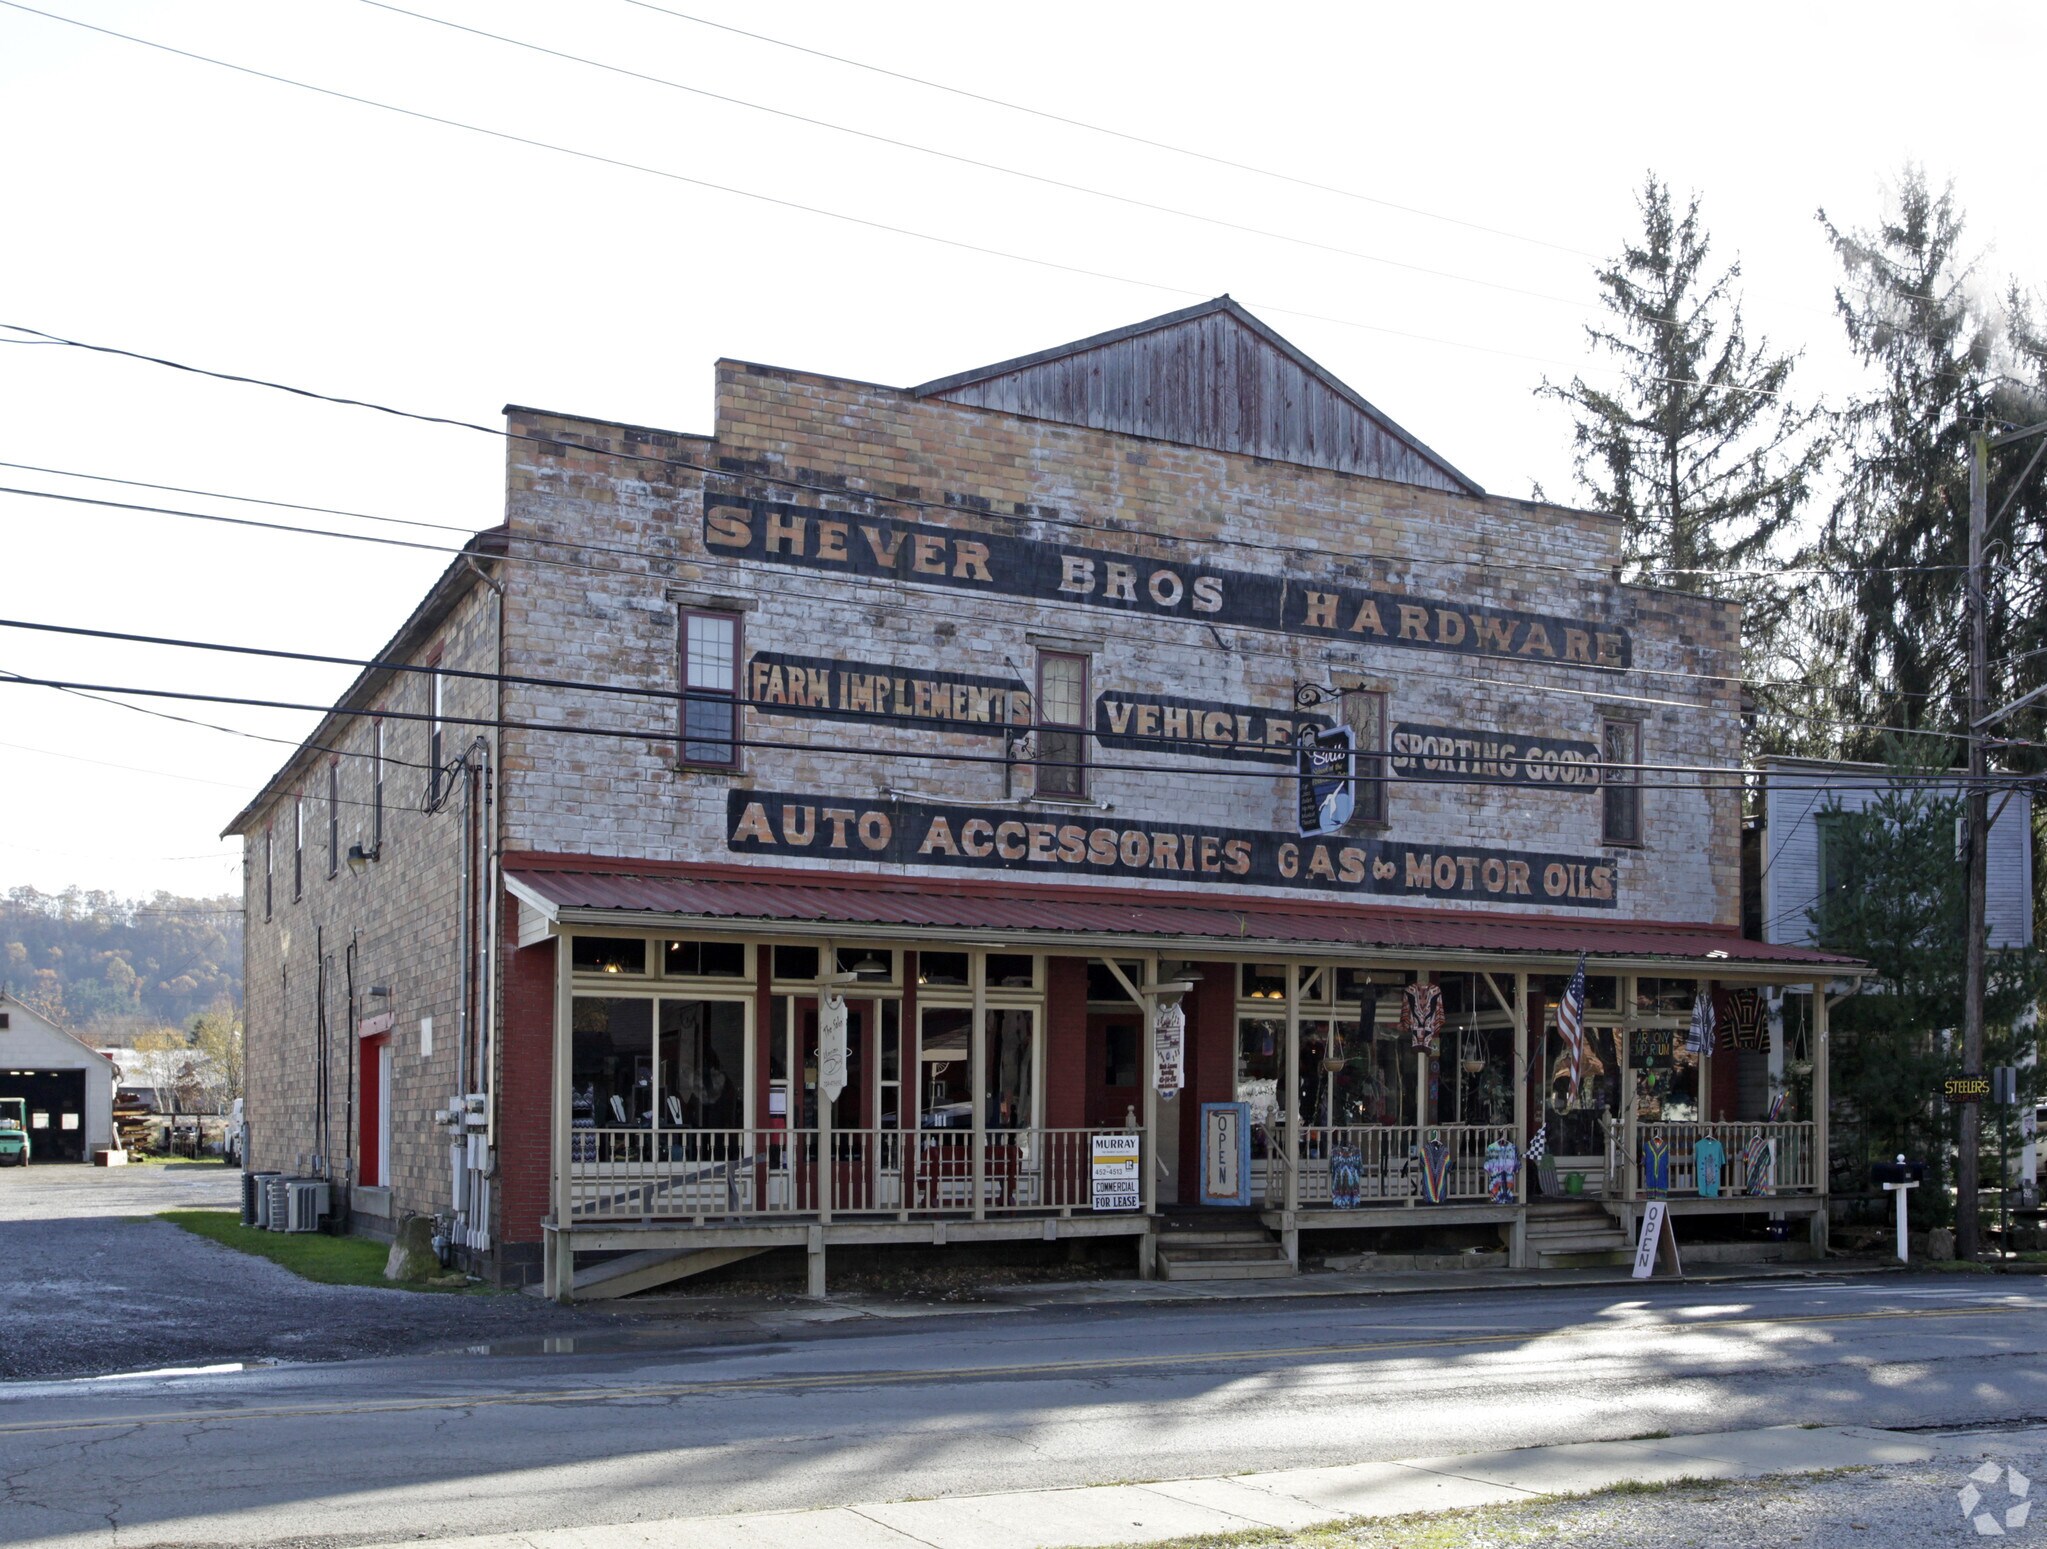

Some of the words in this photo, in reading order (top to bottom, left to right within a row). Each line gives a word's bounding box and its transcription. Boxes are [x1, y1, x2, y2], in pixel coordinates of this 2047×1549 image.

[706, 504, 994, 582] SHEVER
[1057, 555, 1223, 613] BROS
[1301, 589, 1623, 668] HARDWARE
[752, 661, 830, 709] FARM
[839, 671, 1031, 726] IMPLEMENTS
[1103, 699, 1327, 756] VEHICLE
[1393, 732, 1517, 778] SPORTING
[1525, 746, 1600, 785] GOODS
[731, 801, 893, 851] AUTO
[918, 815, 1252, 875] ACCESSORIES
[1278, 842, 1366, 883] GAS
[1405, 852, 1533, 895] MOTOR
[1543, 862, 1613, 900] OILS
[1630, 1032, 1670, 1044] ARONY
[1630, 1043, 1670, 1056] EMPRUM
[1945, 1080, 1990, 1094] STEELERS
[1095, 1139, 1136, 1149] MURRAY
[1218, 1116, 1227, 1184] OPEN
[1095, 1197, 1111, 1208] FOR
[1113, 1195, 1137, 1207] LEASE
[1096, 1181, 1136, 1192] COMMERCIAL
[1638, 1206, 1658, 1267] OPEN
